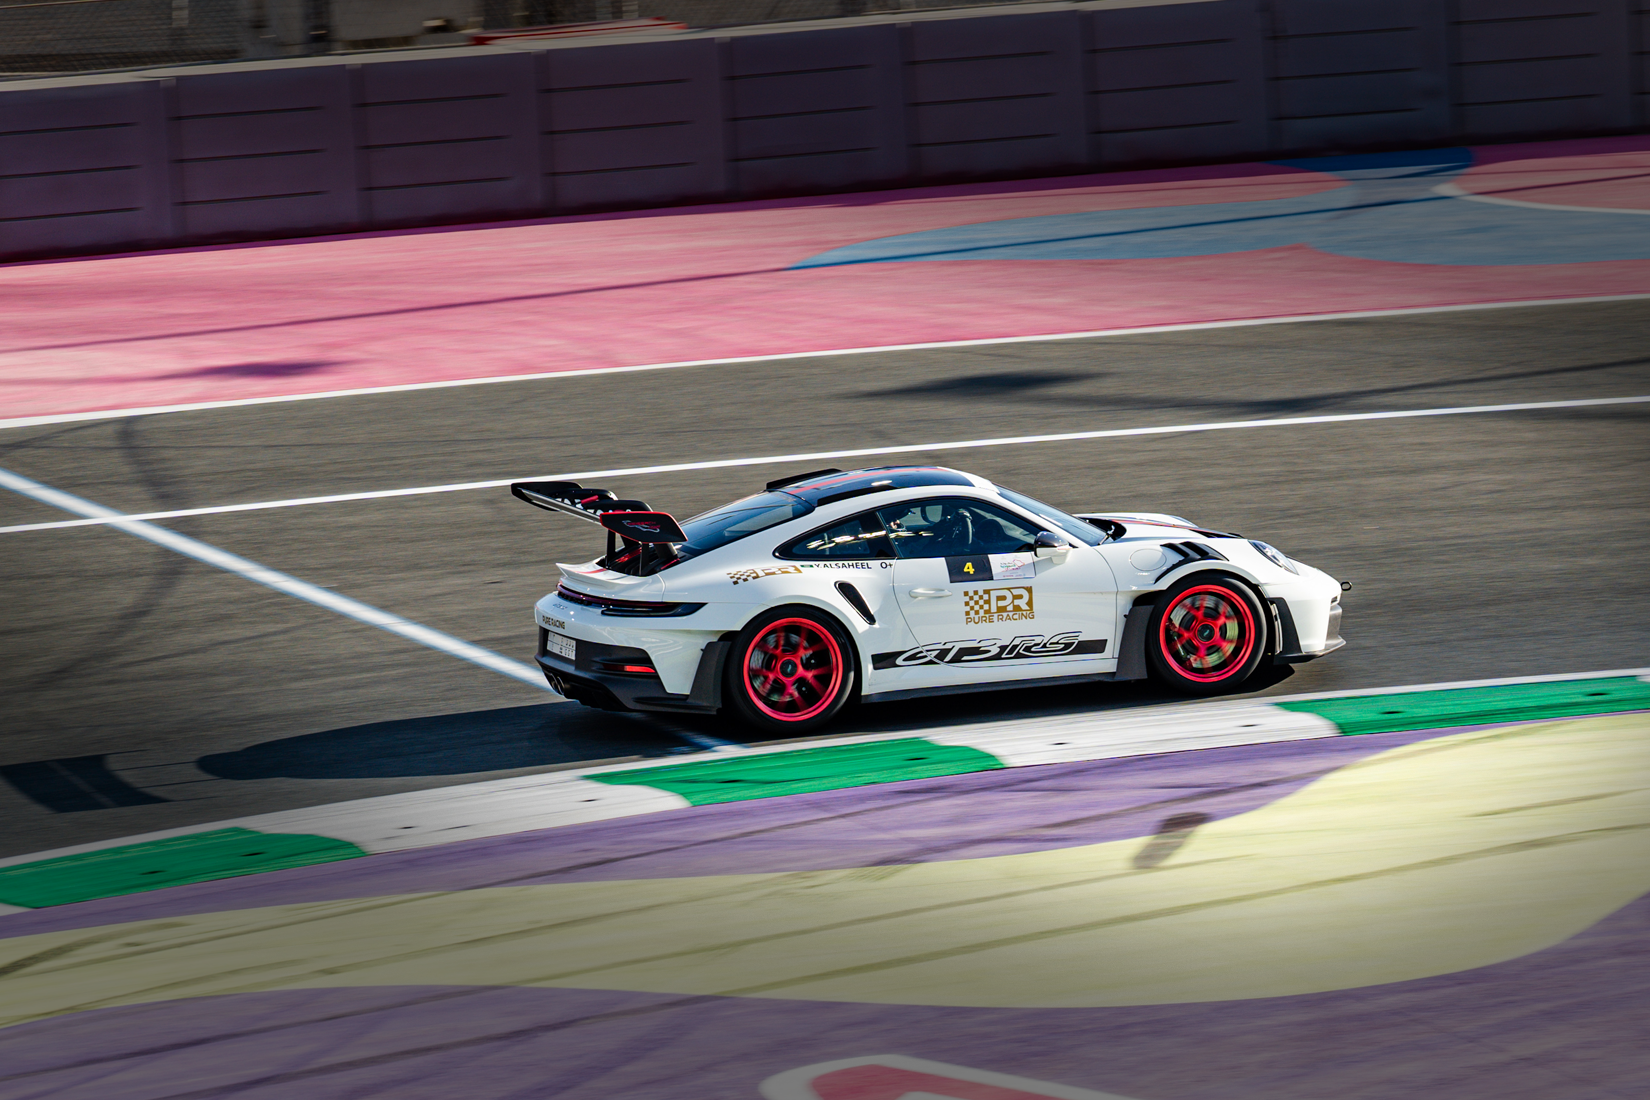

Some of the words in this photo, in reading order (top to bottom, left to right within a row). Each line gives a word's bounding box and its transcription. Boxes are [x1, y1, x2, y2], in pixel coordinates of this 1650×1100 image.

[963, 561, 975, 575] 4
[989, 587, 1031, 613] PR
[965, 614, 995, 625] PURE
[996, 611, 1035, 623] RACING
